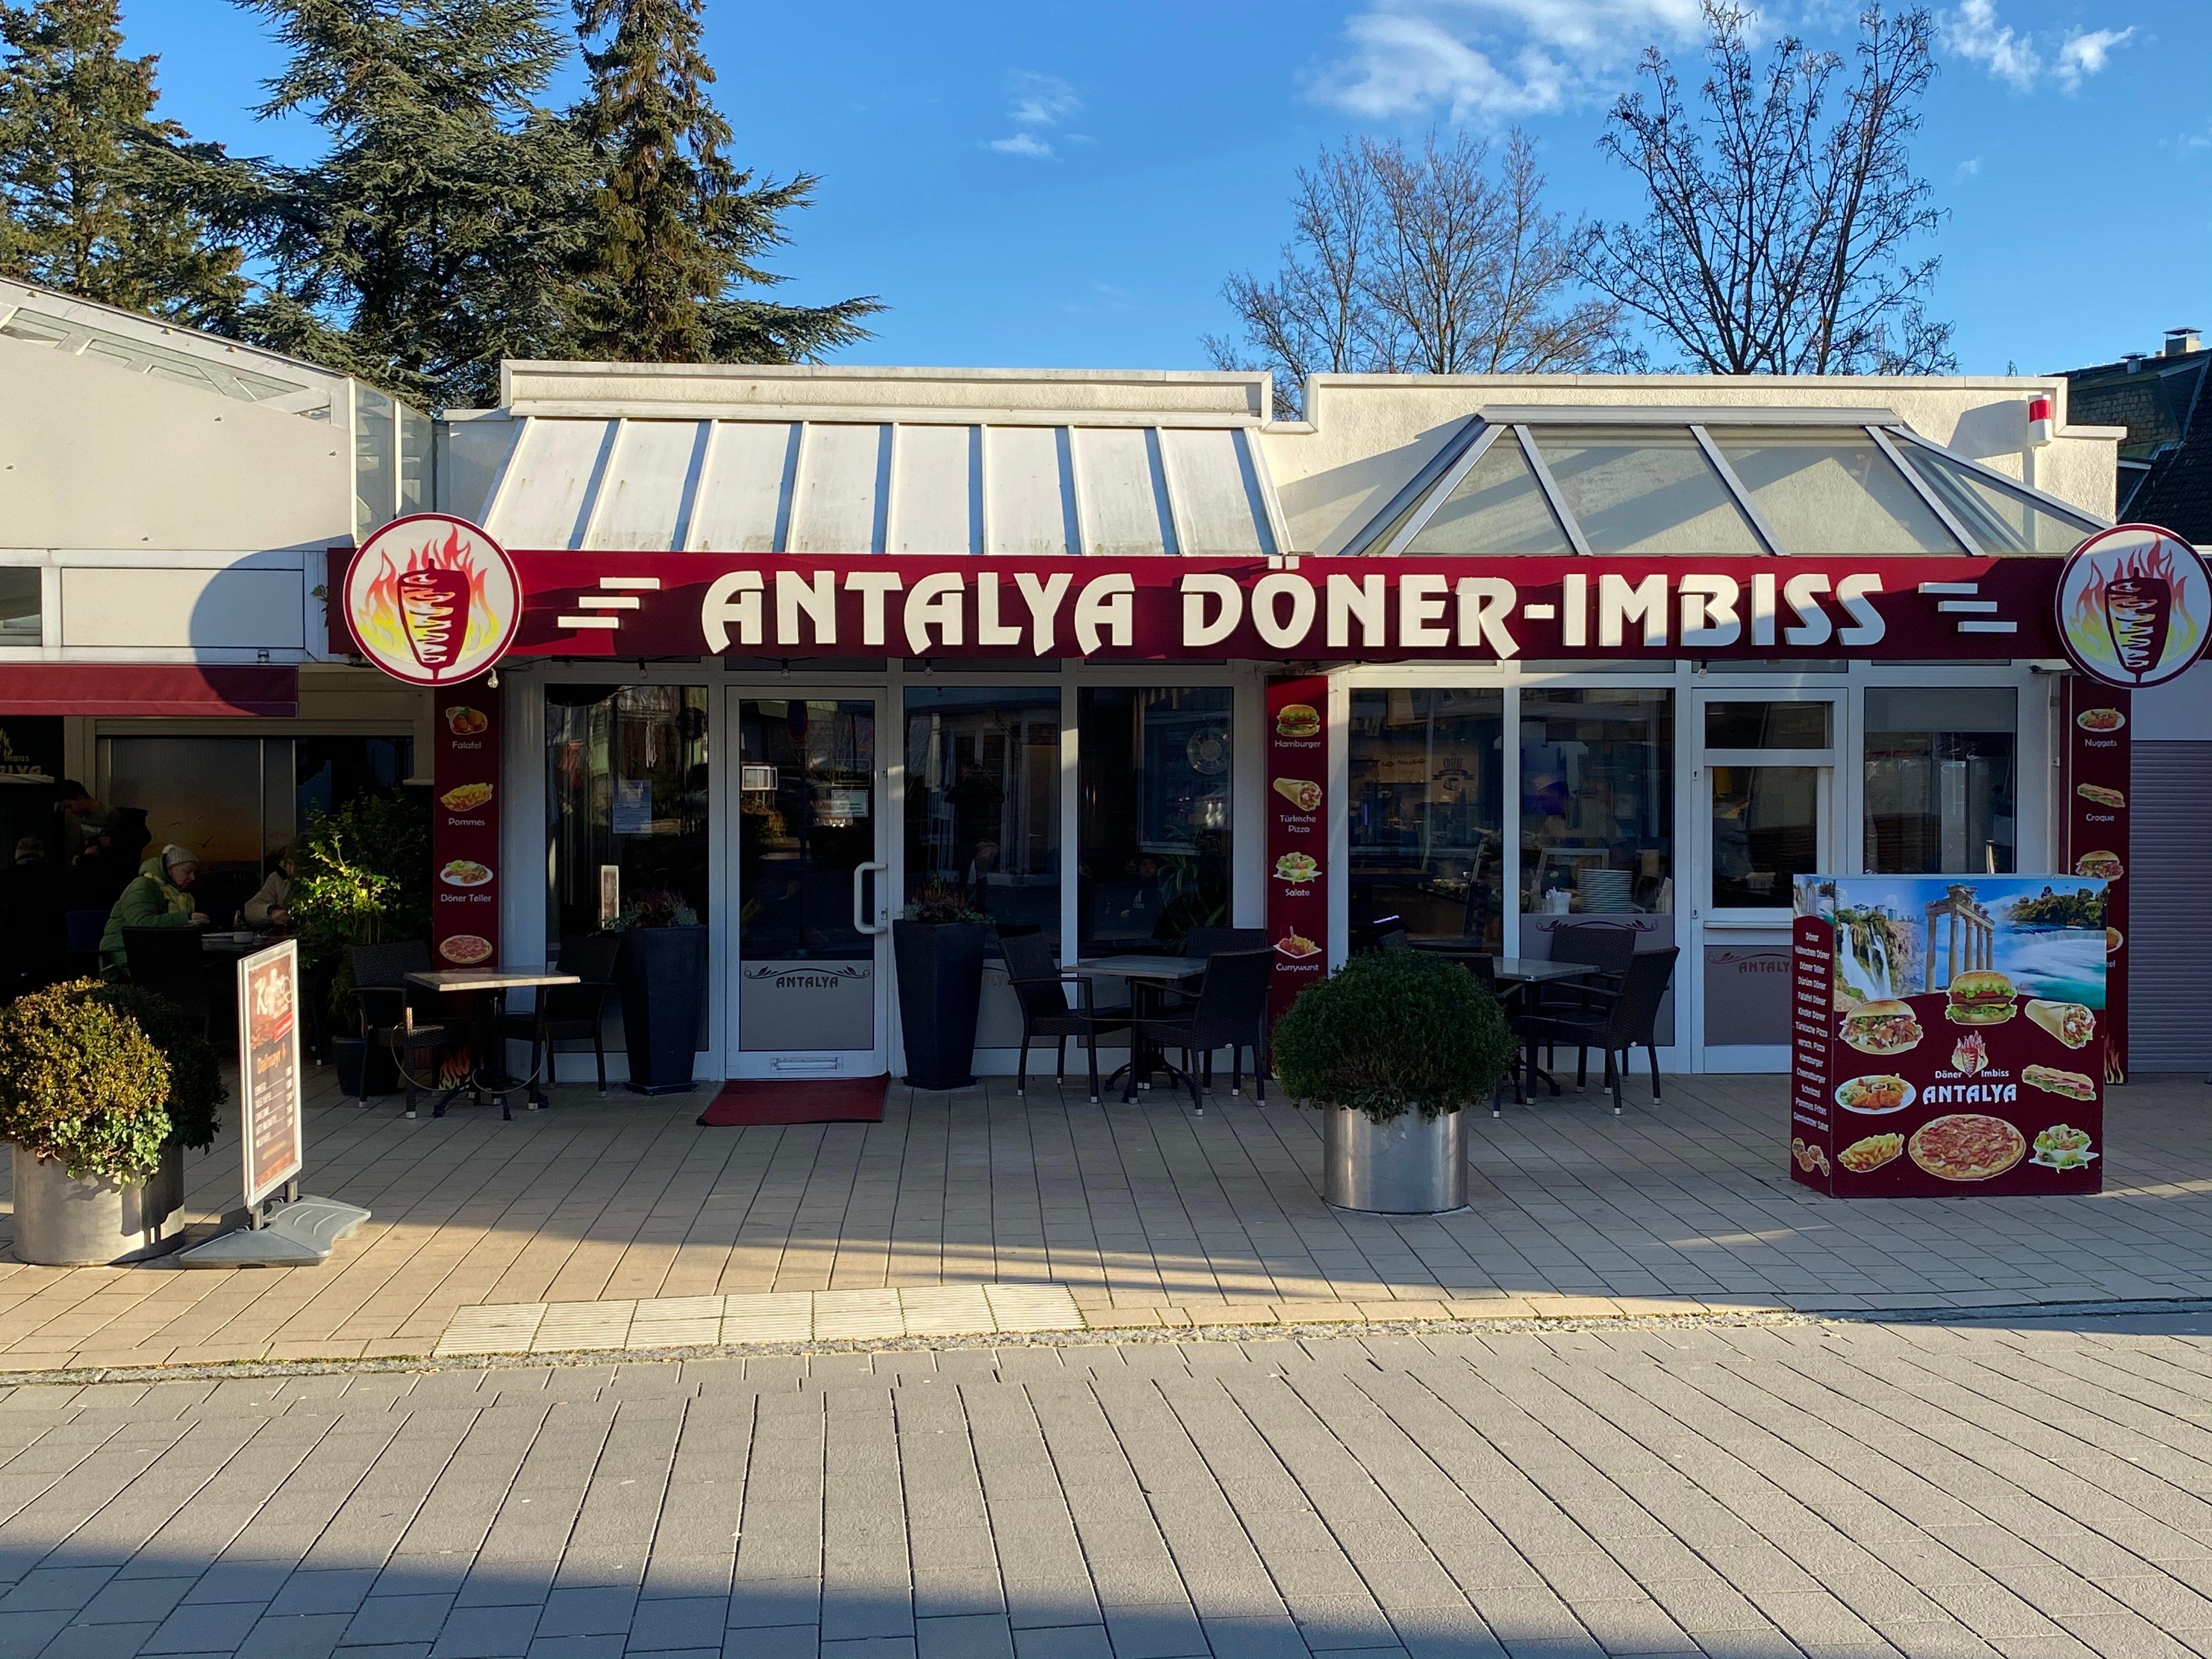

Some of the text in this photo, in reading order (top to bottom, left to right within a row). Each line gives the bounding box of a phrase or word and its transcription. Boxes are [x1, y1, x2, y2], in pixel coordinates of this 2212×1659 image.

[702, 556, 1886, 659] ANTALYA DÖNER-IMBISS
[452, 741, 482, 749] Falafel
[1274, 740, 1321, 748] Hamburger
[2085, 739, 2117, 748] Nuggets
[448, 818, 485, 826] Pommes
[2086, 814, 2115, 822] Croque
[1285, 888, 1311, 896] Salate
[441, 893, 466, 902] Döner
[1276, 963, 1319, 972] Currywurst
[1739, 962, 1792, 973] ANTALY
[776, 977, 839, 988] ANTALYA
[1935, 1069, 2010, 1079] Döner Imbiss
[1922, 1084, 2017, 1105] ANTALYA
